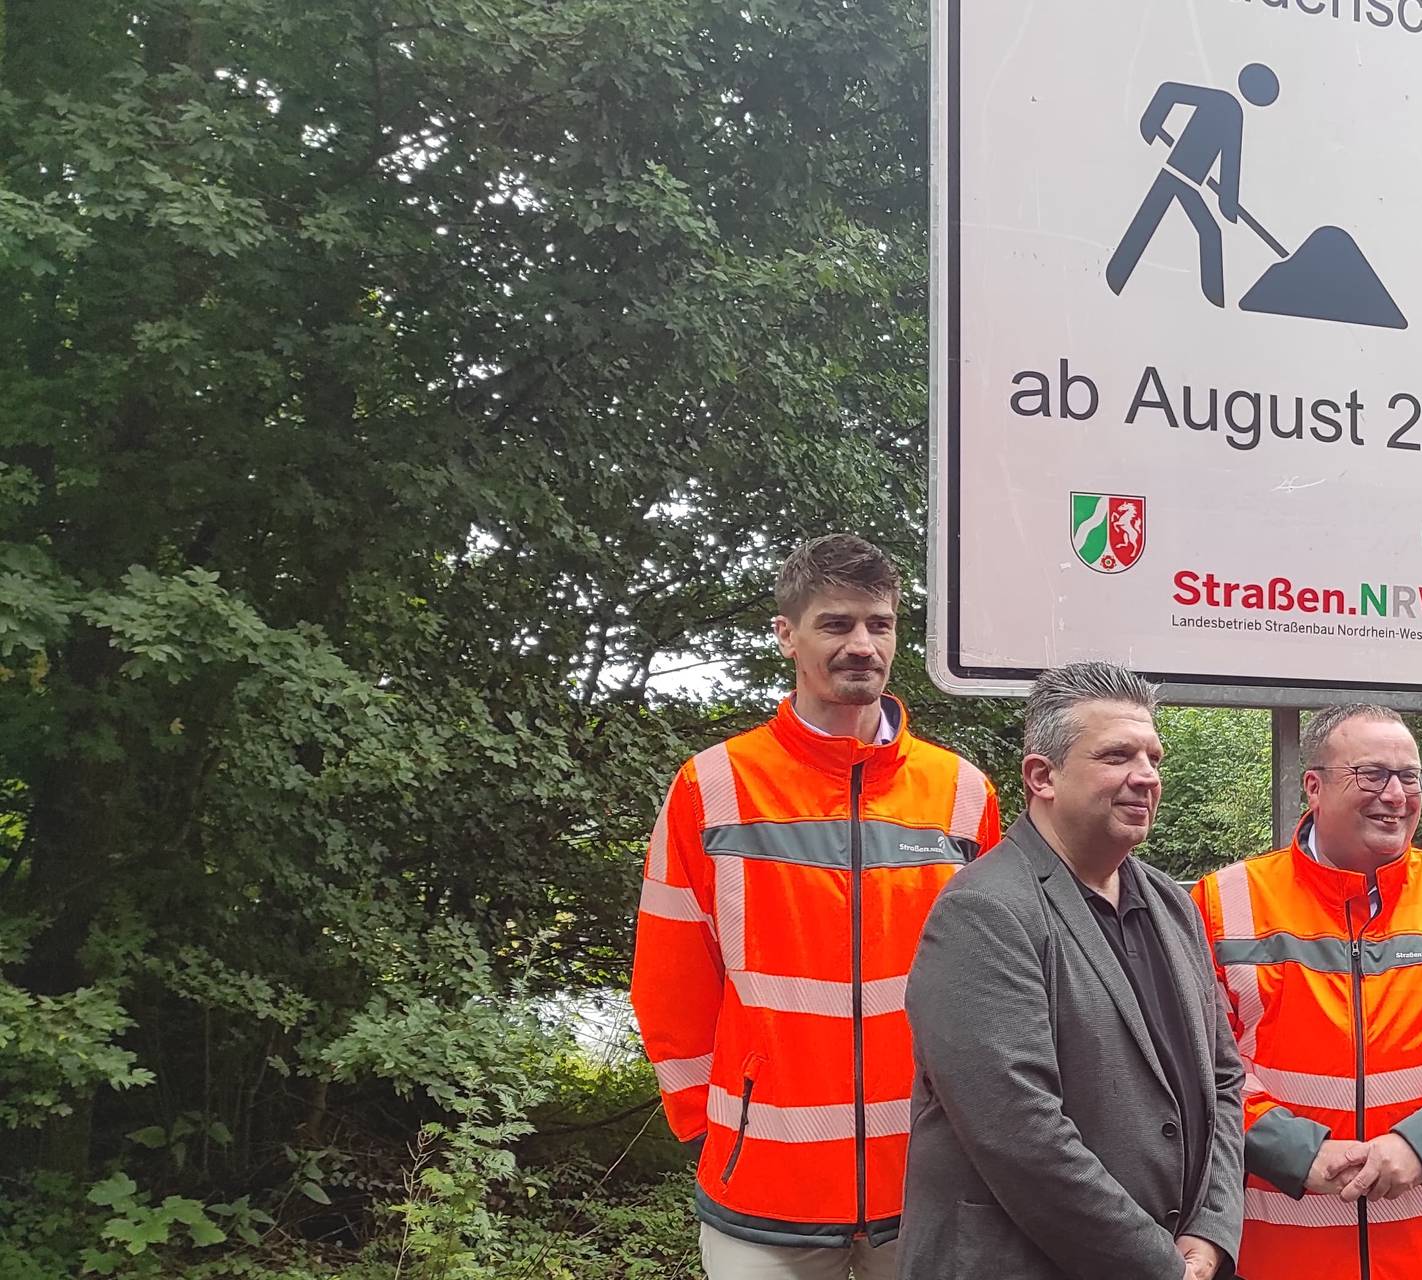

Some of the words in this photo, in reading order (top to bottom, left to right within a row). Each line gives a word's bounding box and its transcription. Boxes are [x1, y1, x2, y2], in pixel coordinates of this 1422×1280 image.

[1009, 358, 1099, 421] ab
[1124, 365, 1365, 450] August
[1171, 614, 1262, 631] Landesbetrieb
[1265, 619, 1335, 636] Straßenbau
